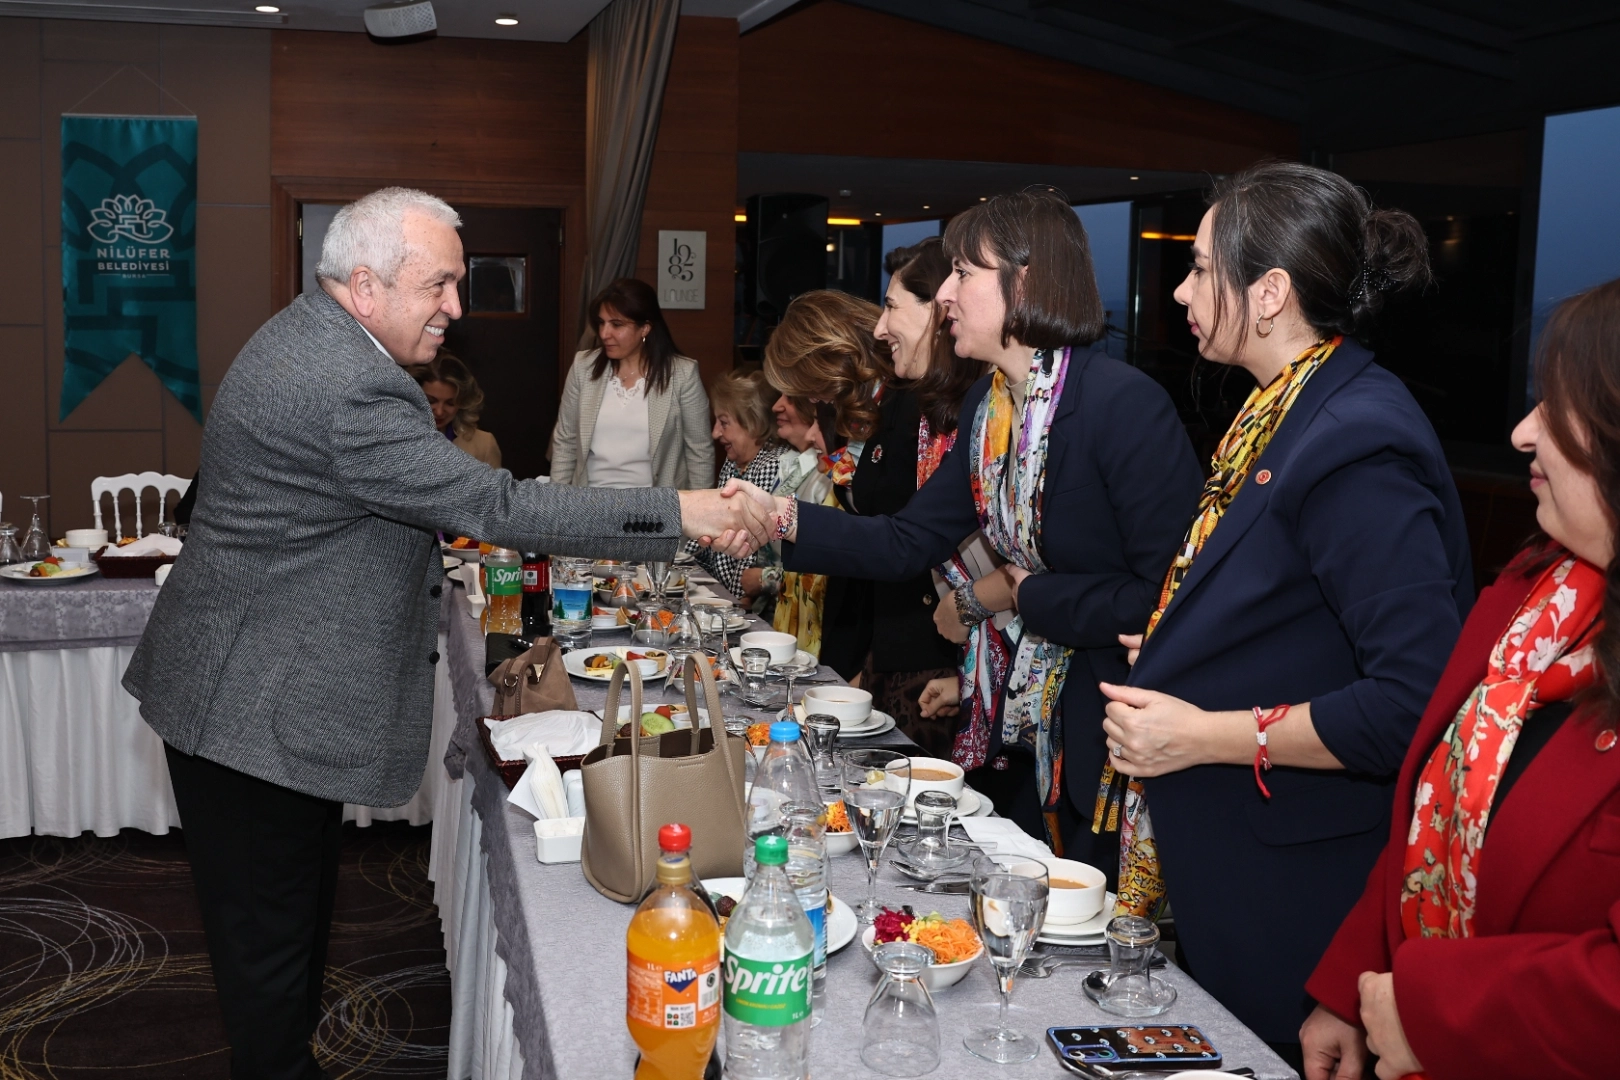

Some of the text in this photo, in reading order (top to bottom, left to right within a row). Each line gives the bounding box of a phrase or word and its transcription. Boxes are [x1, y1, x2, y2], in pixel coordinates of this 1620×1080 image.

[96, 245, 170, 259] NİLÜFER
[98, 260, 169, 271] BELEDİYESİ
[494, 567, 522, 585] Sprit
[664, 968, 697, 983] FANTA
[724, 955, 807, 995] Sprite
